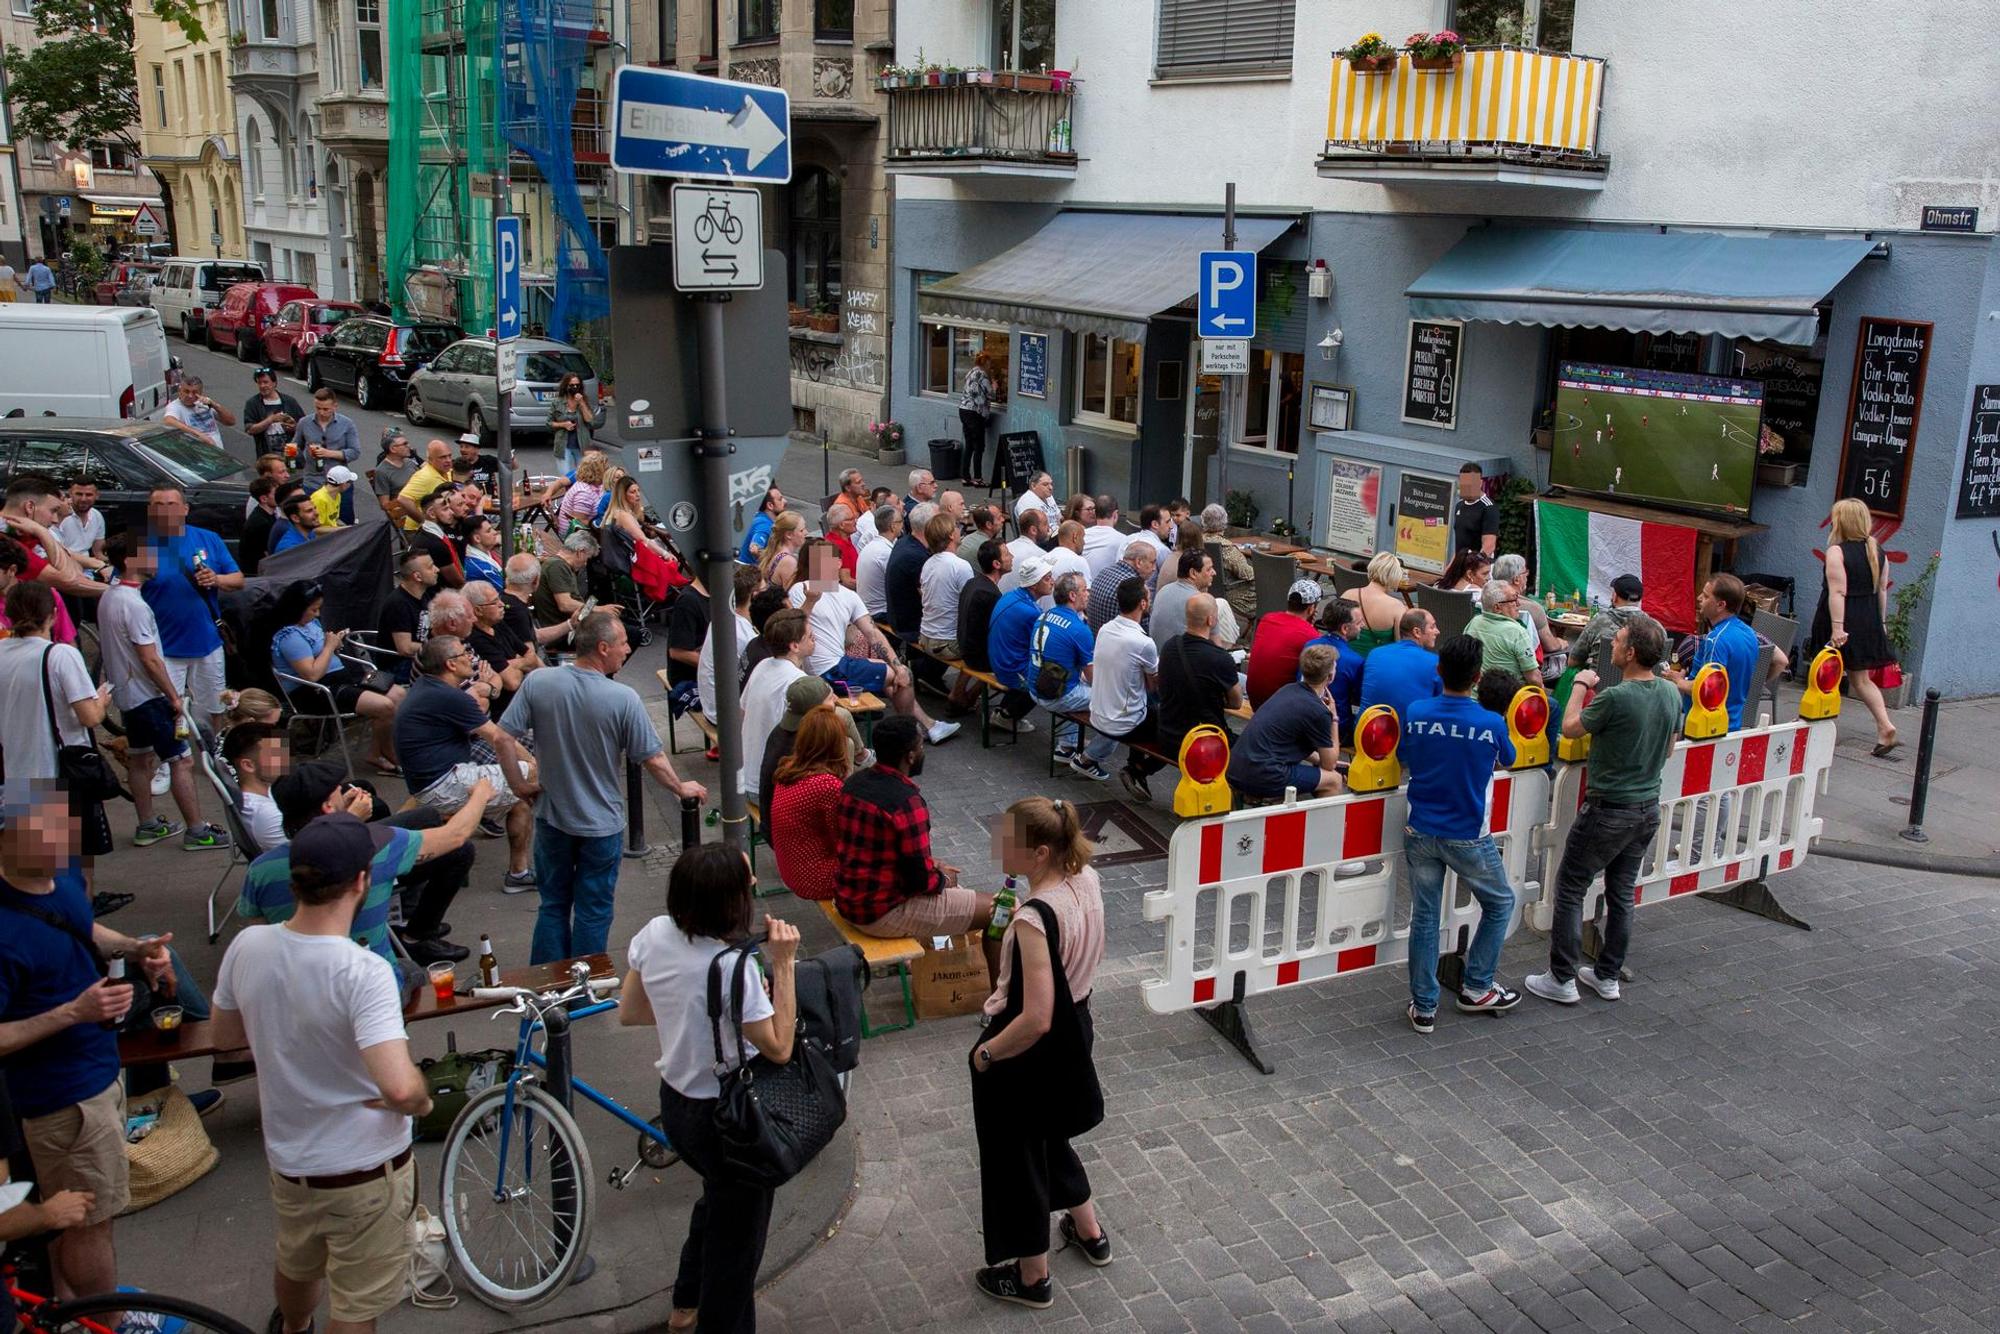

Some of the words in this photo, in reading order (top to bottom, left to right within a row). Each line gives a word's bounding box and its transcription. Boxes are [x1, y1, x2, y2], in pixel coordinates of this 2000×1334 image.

[1927, 210, 1971, 225] Ohmstr.
[502, 232, 515, 299] P
[1210, 261, 1244, 308] P
[1867, 324, 1924, 355] Longdrinks
[1864, 360, 1909, 383] Gin-Tonic
[1862, 380, 1914, 405] Vodka-Soda
[1859, 402, 1912, 426] Vodka-Lemon
[1853, 421, 1908, 454] Campari-Orange
[1407, 721, 1495, 744] ITALIA
